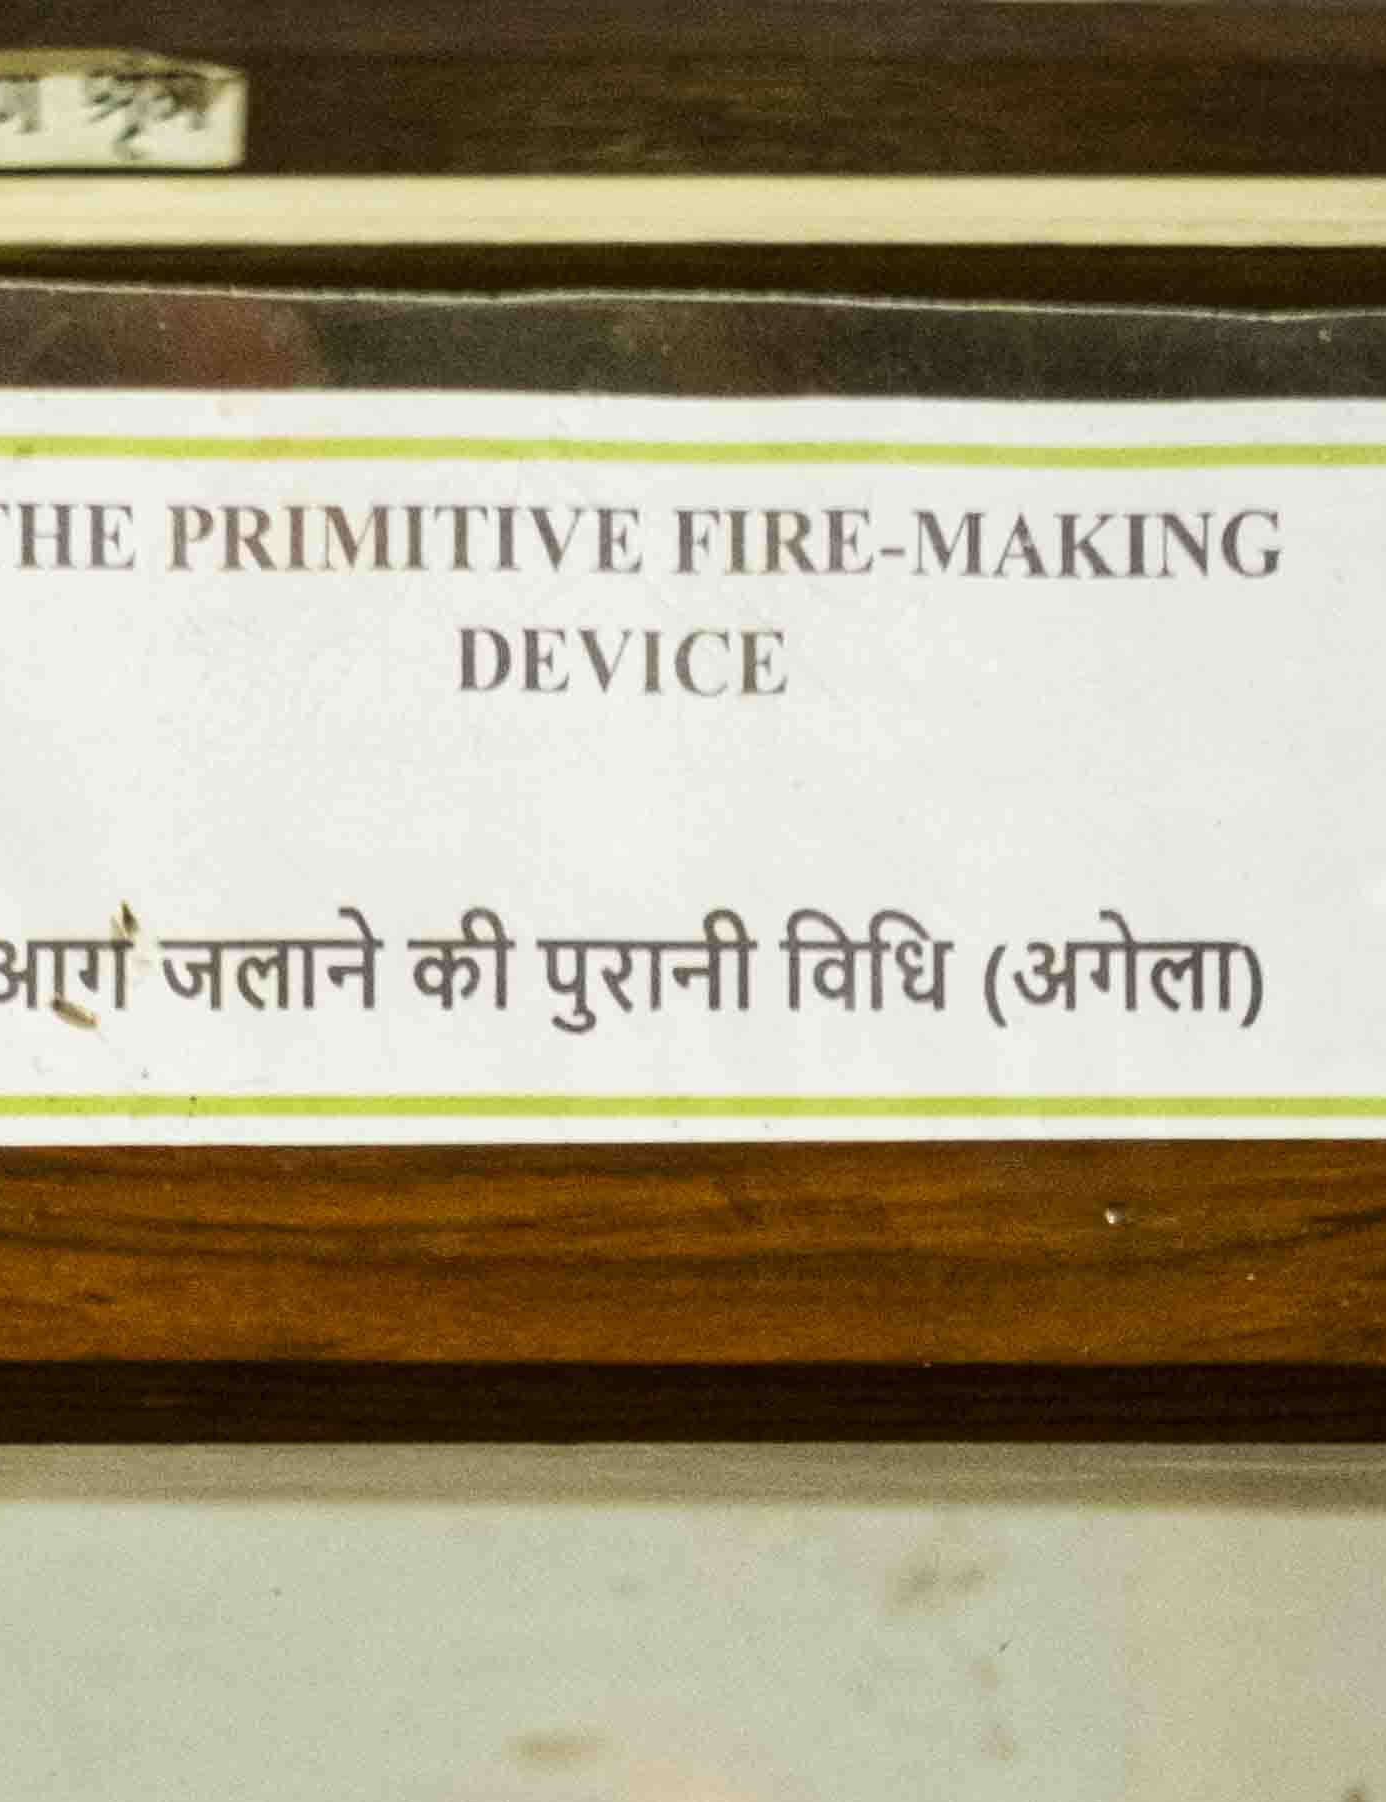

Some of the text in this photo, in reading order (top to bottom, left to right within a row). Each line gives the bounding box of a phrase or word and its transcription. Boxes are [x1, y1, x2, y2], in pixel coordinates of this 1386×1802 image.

[168, 507, 641, 572] PRIMITIVE
[675, 508, 1283, 578] FIRE-MAKING
[457, 627, 787, 695] DEVICE
[159, 907, 383, 1010] जलाने
[407, 907, 516, 1010] की
[536, 908, 757, 1034] पुरानी
[778, 908, 955, 1012] विधि
[983, 910, 1265, 1027] (अगेला)
